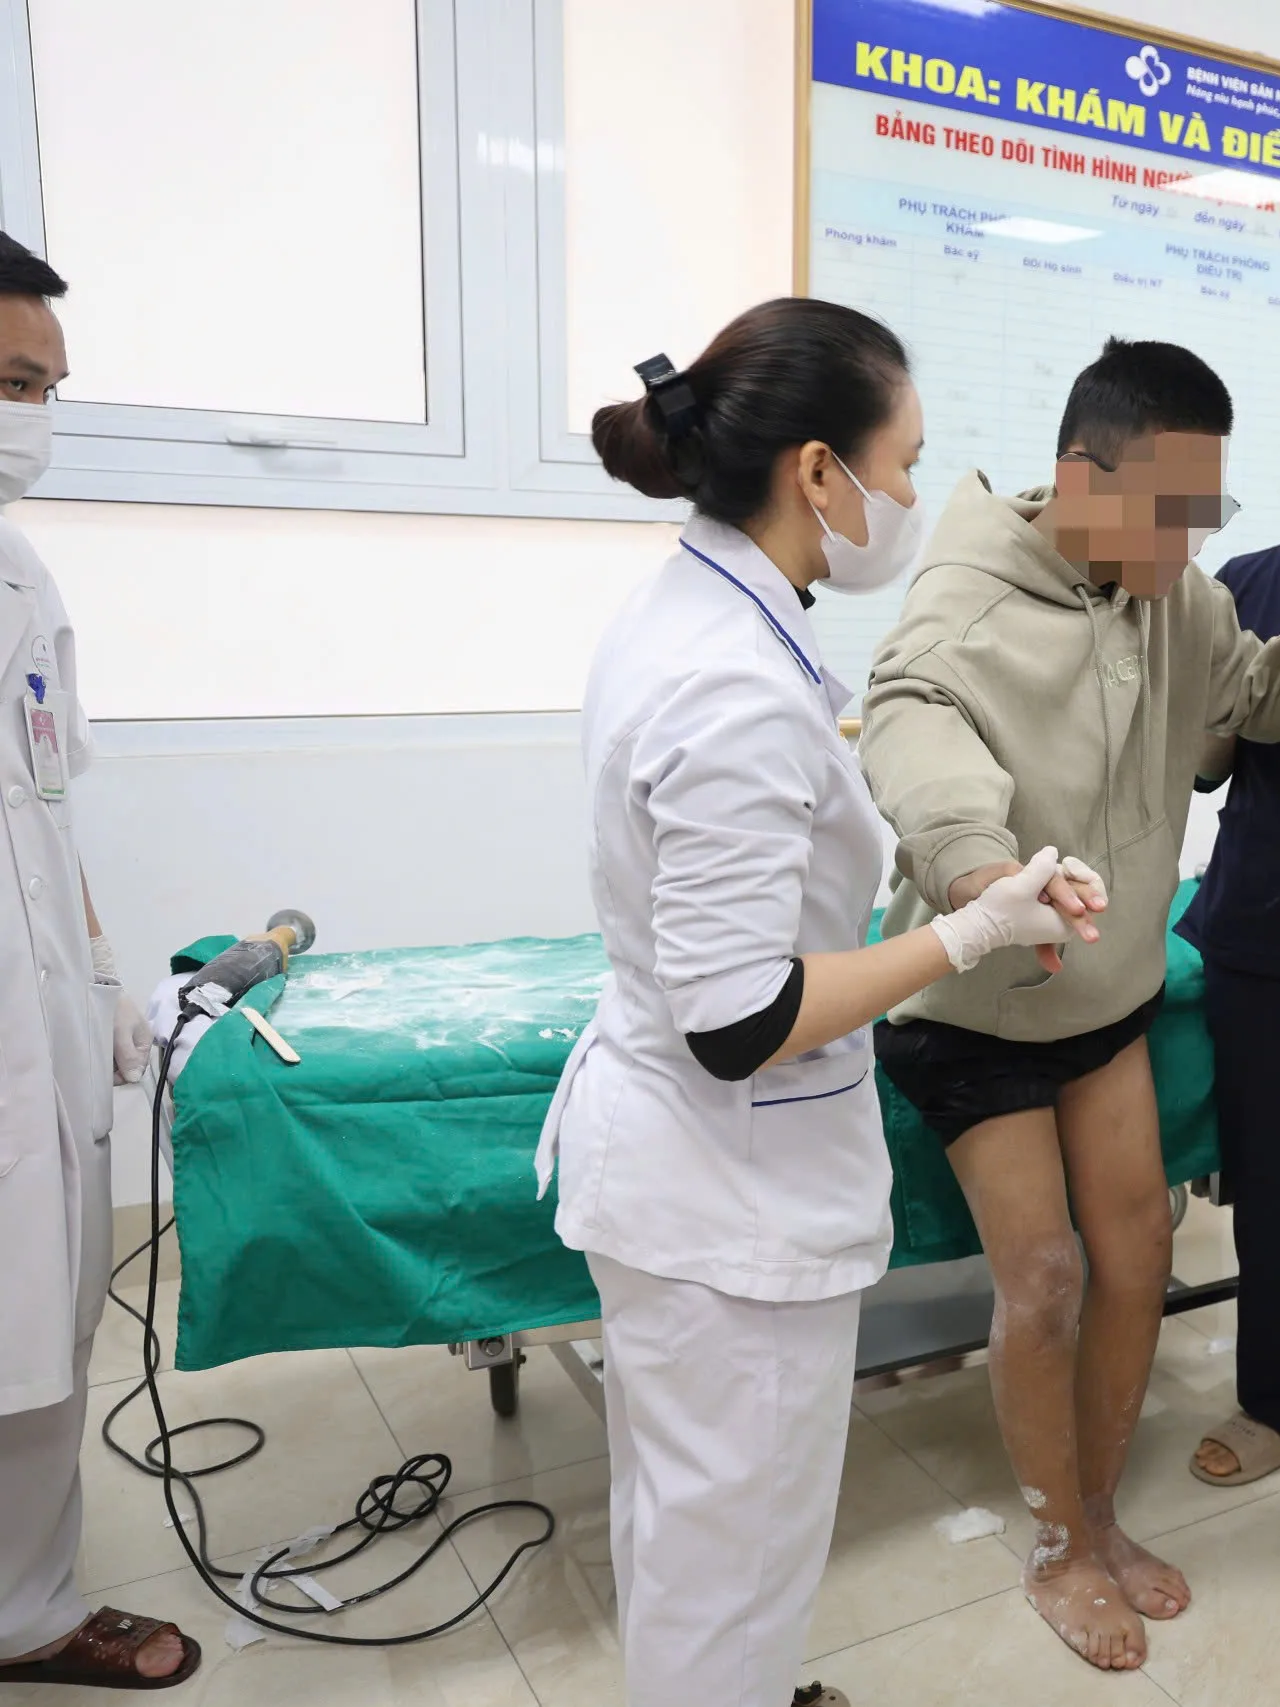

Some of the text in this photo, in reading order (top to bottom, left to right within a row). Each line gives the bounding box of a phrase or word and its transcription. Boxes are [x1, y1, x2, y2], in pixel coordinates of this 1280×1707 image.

[855, 41, 1001, 105] KHOA:
[1016, 78, 1146, 138] KHÁM
[1159, 111, 1211, 152] VÀ
[875, 109, 936, 146] BẢNG
[942, 126, 995, 157] THEO
[1001, 137, 1034, 165] DÕI
[1041, 144, 1085, 175] TÌNH
[1092, 155, 1137, 185] HÌNH
[898, 197, 928, 216] PHỤ
